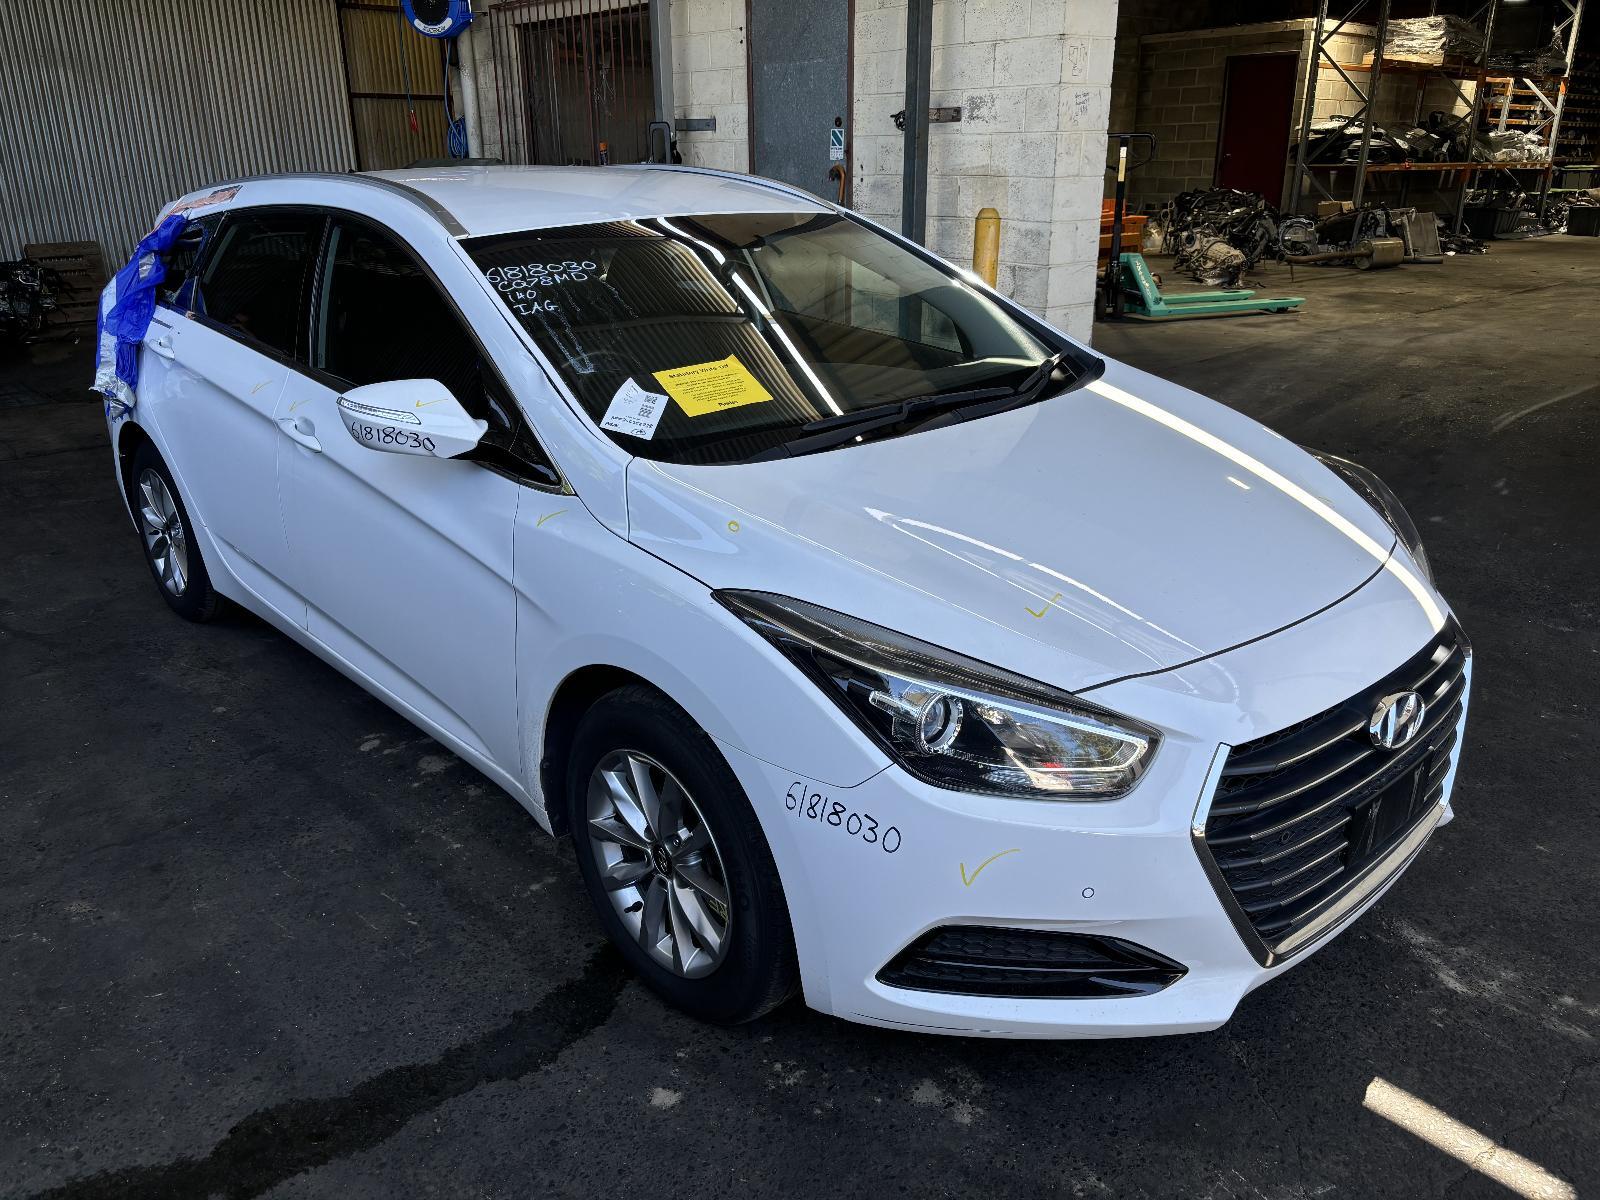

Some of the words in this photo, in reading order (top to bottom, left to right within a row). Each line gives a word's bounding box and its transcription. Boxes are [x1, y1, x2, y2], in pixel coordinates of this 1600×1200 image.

[485, 260, 597, 283] 61818030
[498, 271, 588, 292] CQ78MD
[513, 299, 559, 315] IAG
[351, 421, 436, 452] 61818030
[785, 781, 901, 853] 61818030
